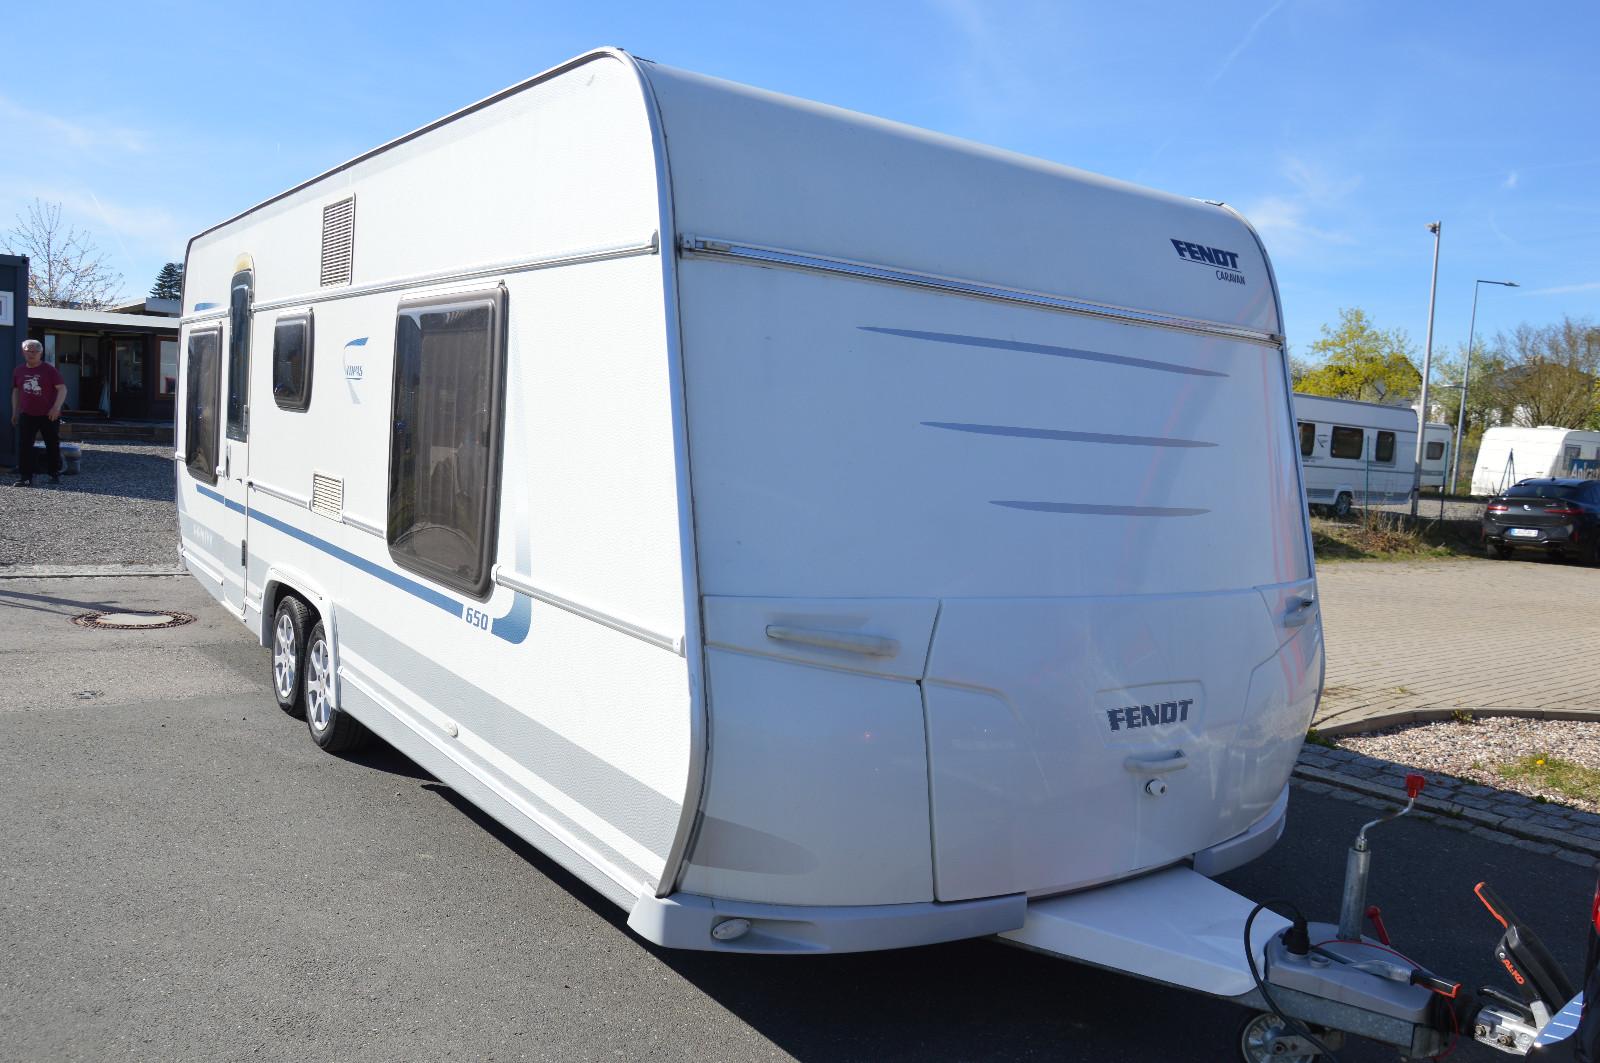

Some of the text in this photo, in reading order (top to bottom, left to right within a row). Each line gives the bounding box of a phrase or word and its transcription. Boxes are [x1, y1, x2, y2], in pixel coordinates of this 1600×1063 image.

[1170, 239, 1239, 269] FENDT
[1215, 270, 1246, 285] CARAVAN
[466, 607, 488, 630] 650
[1107, 699, 1193, 732] FENDT
